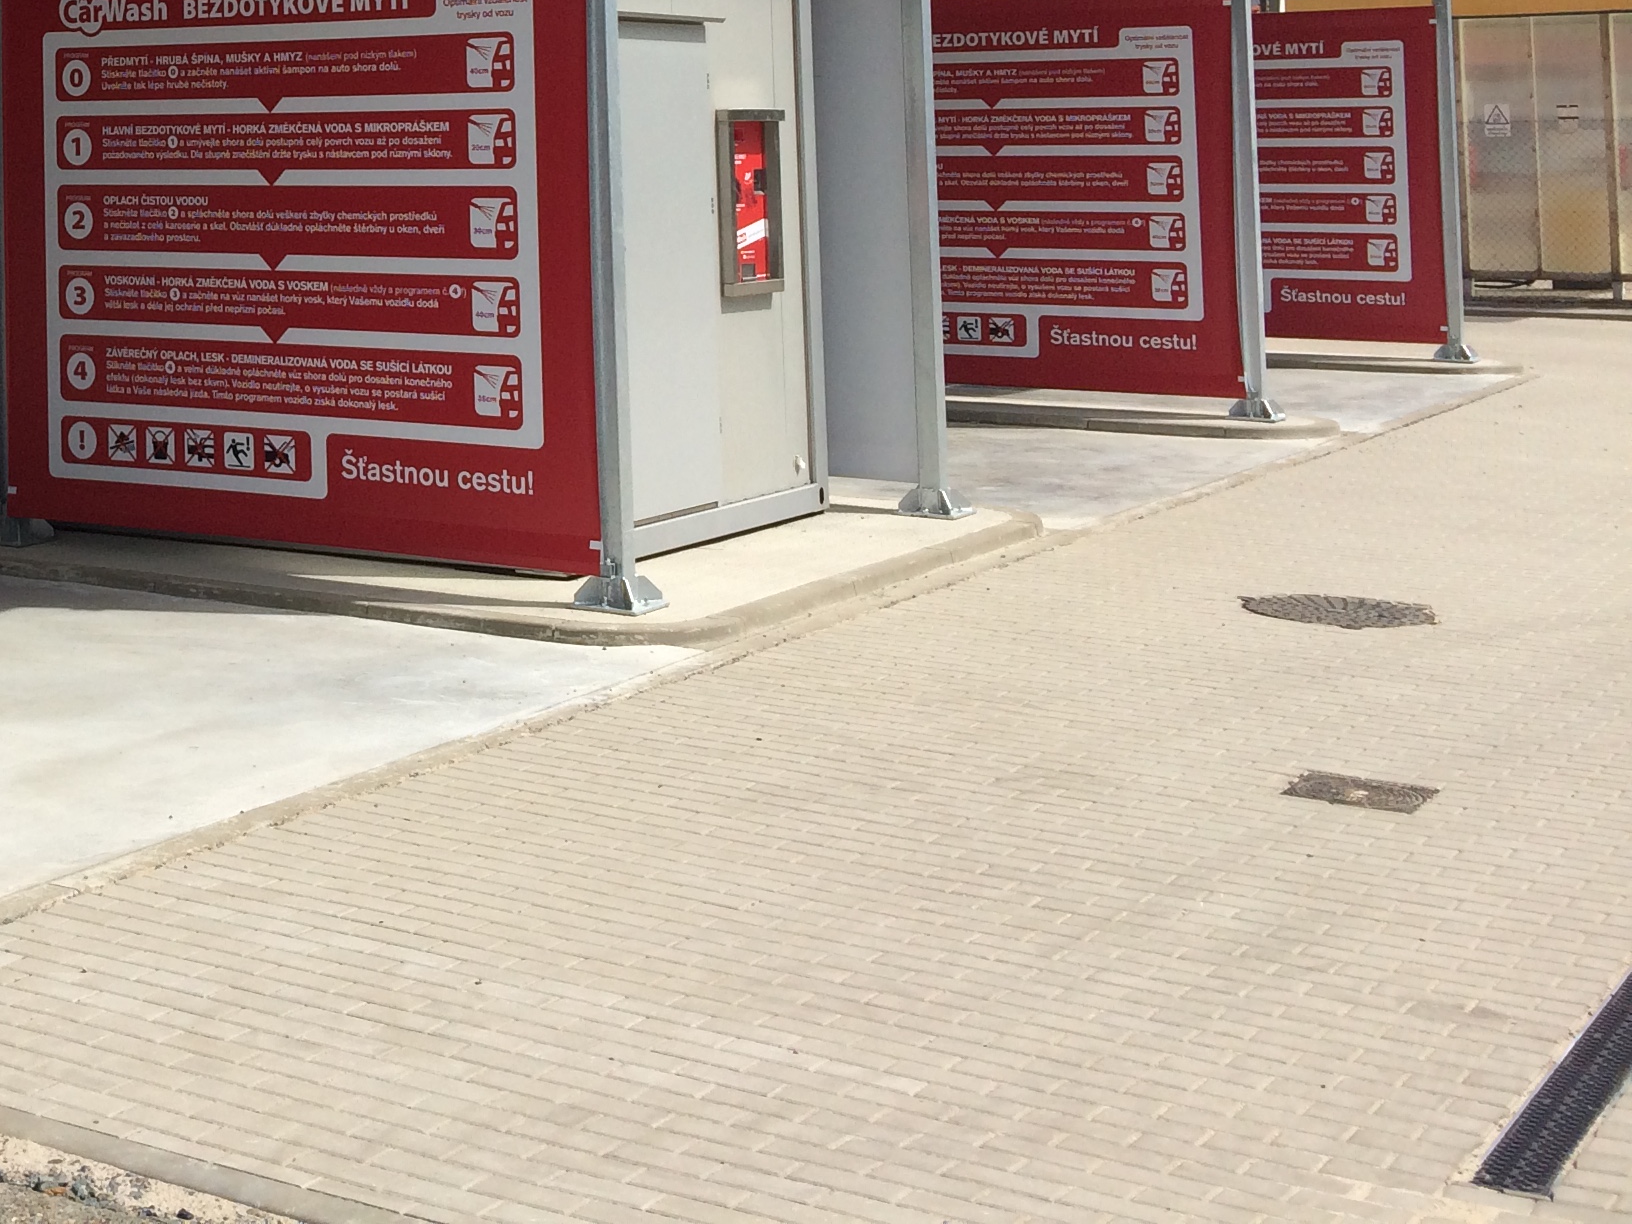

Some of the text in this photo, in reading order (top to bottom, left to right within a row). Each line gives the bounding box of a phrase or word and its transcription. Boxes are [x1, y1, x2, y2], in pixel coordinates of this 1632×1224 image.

[933, 26, 1099, 47] EZDOTYKOVÉ MYTÍ
[1285, 40, 1324, 55] MYTÍ
[101, 54, 148, 66] PŘEDMYTÍ
[156, 53, 188, 65] HRUBÁ
[226, 52, 260, 63] MUŠKY
[263, 54, 271, 62] A
[273, 51, 303, 61] HMYZ
[102, 124, 133, 135] HLAVNÍ
[135, 123, 201, 135] BEZDOTYKOVÉ
[203, 123, 226, 134] MYTÍ
[232, 124, 266, 134] HORKÁ
[268, 120, 322, 134] ZMĚKČENÁ
[325, 123, 352, 133] VODA
[354, 123, 361, 132] S
[364, 119, 449, 133] MIKROPRÁŠKEM
[103, 194, 208, 206] OPLACH ČISTOU VODOU
[104, 275, 328, 291] VOSKOVÁNÍ HORKÁ ZMĚKČENÁ VODA S VOSKEM
[1280, 286, 1406, 306] Šťastnou cestu!
[1050, 324, 1197, 350] Šťastnou cestu!
[106, 347, 158, 360] ZÁVĚREČNÝ
[160, 351, 199, 362] OPLACH,
[201, 353, 224, 362] LESK
[231, 354, 327, 368] DEMINERALIZOVANÁ
[330, 359, 358, 370] VODA
[360, 361, 374, 371] SE
[376, 359, 409, 372] SUŠÍCÍ
[412, 361, 452, 375] LÁTKOU
[341, 448, 534, 495] Šťastnou cestu!
